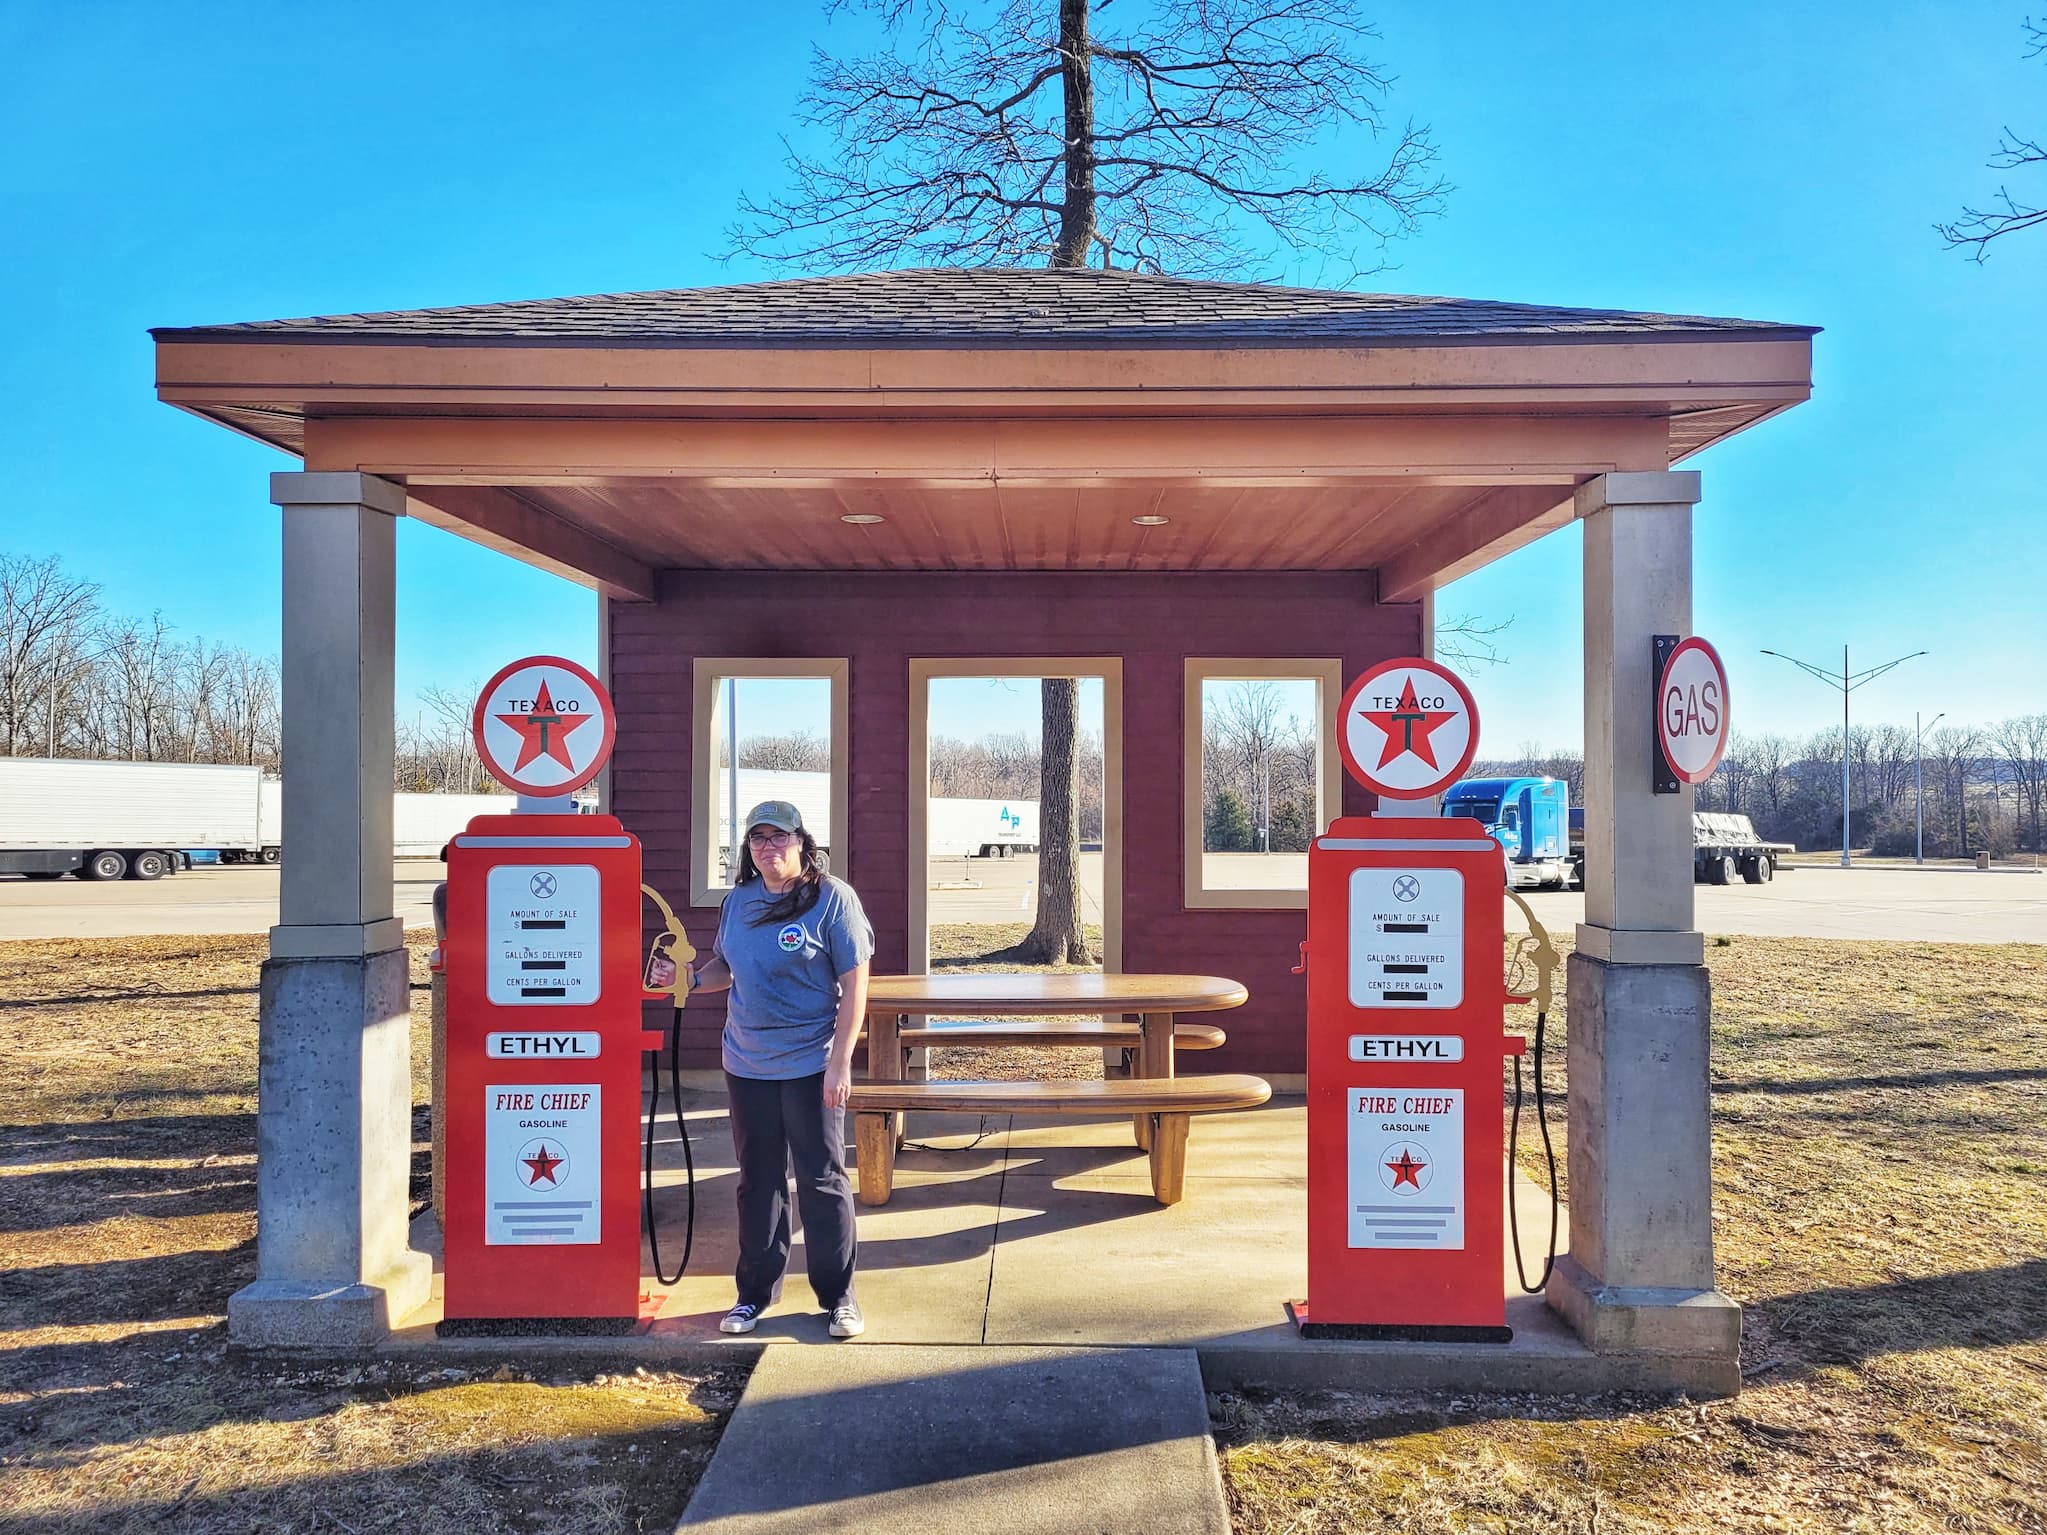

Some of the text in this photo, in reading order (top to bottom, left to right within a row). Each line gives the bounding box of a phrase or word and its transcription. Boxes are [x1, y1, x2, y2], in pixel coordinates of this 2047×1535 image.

[508, 700, 580, 712] TEXACO
[1373, 697, 1445, 709] TEXACO
[1666, 681, 1719, 739] GAS
[527, 716, 561, 753] T
[1392, 714, 1426, 750] T
[510, 910, 578, 918] AMOUNT OF SALE
[1372, 914, 1440, 922] AMOUNT OF SALE
[505, 951, 583, 959] GALLONS DELIVERED
[1366, 954, 1445, 963] GALLONS DELIVERED
[506, 978, 581, 986] CENTS PER GALLON
[1368, 982, 1444, 990] CENTS PER GALLON
[500, 1038, 586, 1054] ETHYL
[1363, 1040, 1448, 1057] ETHYL
[496, 1093, 591, 1110] FIRE CHIEF
[1358, 1097, 1454, 1114] FIRE CHIEF
[519, 1120, 568, 1128] GASOLINE
[1382, 1124, 1431, 1132] GASOLINE
